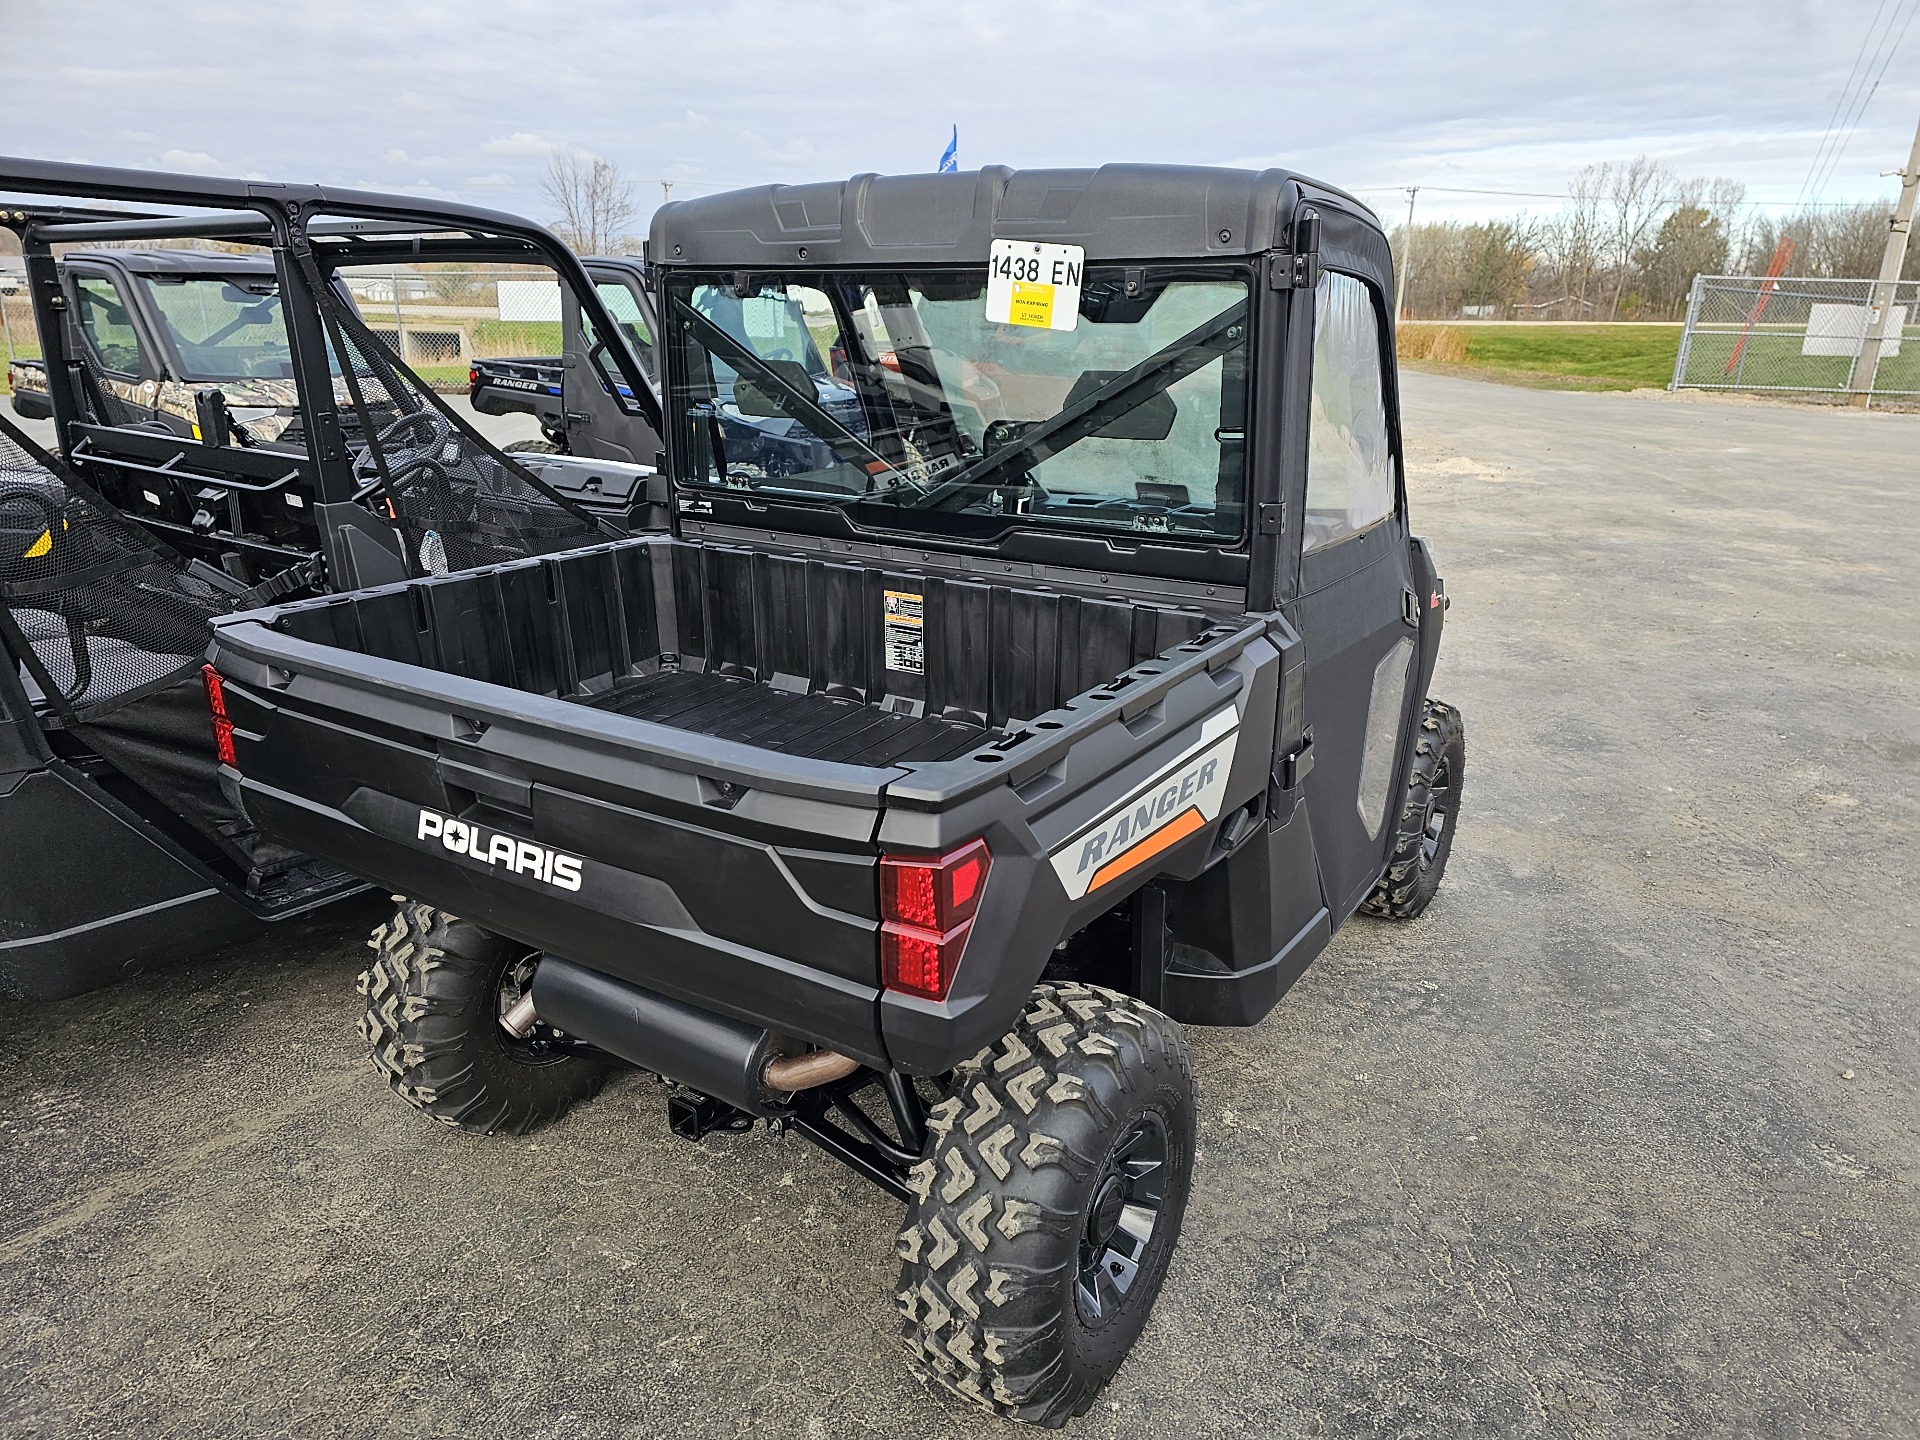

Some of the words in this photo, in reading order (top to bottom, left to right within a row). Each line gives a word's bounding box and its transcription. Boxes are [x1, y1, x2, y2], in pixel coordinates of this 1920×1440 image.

[992, 254, 1040, 282] 1438
[1051, 260, 1081, 287] EN
[492, 377, 538, 391] RANGER
[1077, 757, 1218, 875] RANGER
[417, 809, 583, 892] POLARIS
